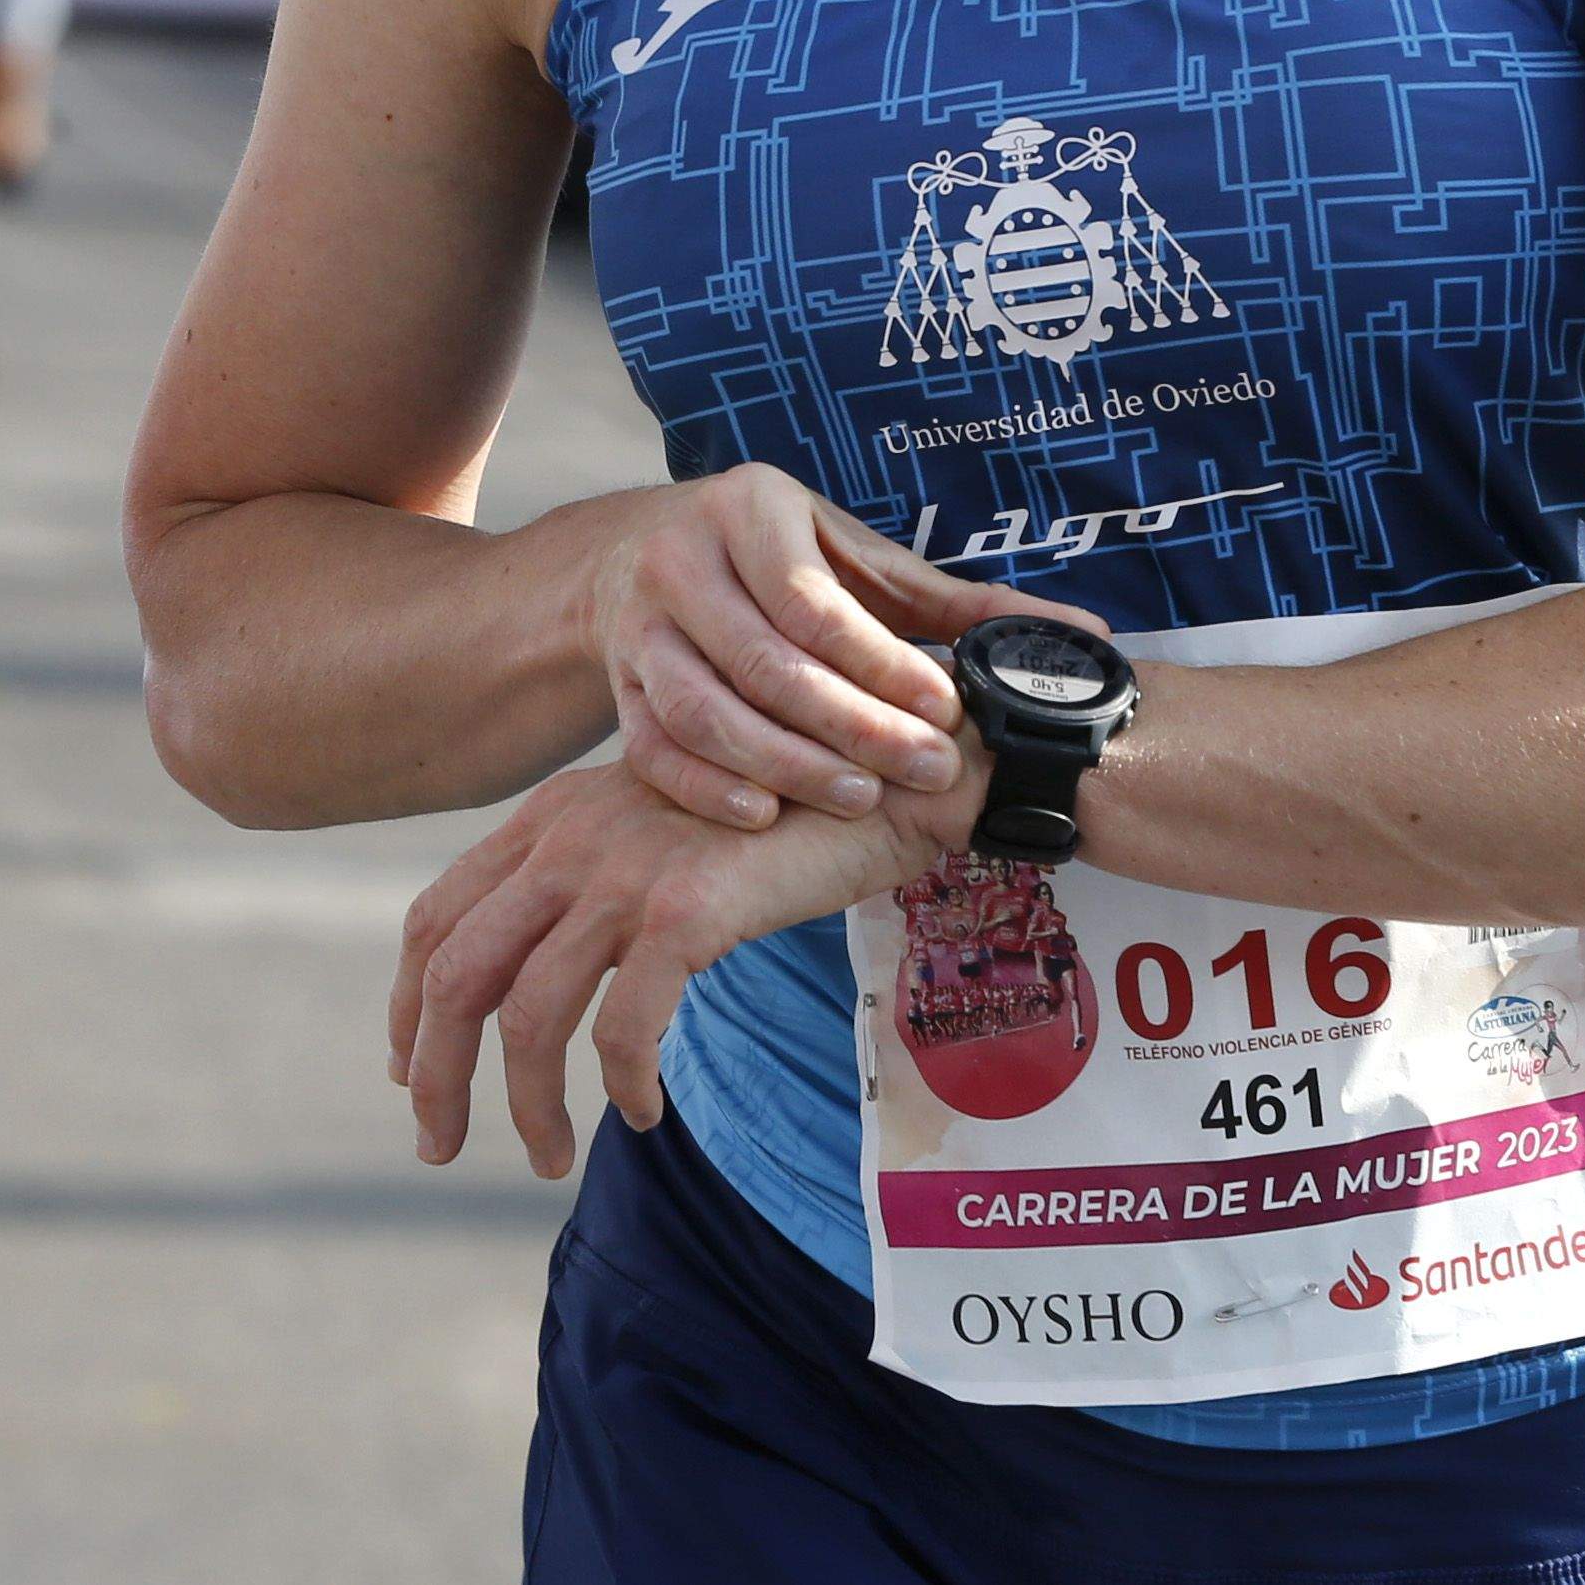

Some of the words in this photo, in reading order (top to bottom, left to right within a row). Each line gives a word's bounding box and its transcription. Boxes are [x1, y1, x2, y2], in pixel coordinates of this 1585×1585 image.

[878, 393, 1094, 455] Universidad
[1102, 388, 1144, 420] de
[1152, 372, 1277, 413] Oviedo
[1115, 916, 1392, 1041] 016
[1124, 1043, 1205, 1061] TELÉFONO
[1209, 1034, 1297, 1057] VIOLENCIA
[1302, 1028, 1324, 1044] DE
[1328, 1017, 1392, 1041] GÉNERO
[1468, 1039, 1527, 1062] Carrera
[1200, 1067, 1324, 1139] 461
[1508, 1056, 1551, 1087] Mujer
[956, 1185, 1169, 1229] CARRERA
[1183, 1180, 1247, 1217] DE
[1262, 1171, 1321, 1210] LA
[1335, 1140, 1481, 1201] MUJER
[1497, 1117, 1579, 1169] 2023
[952, 1289, 1184, 1345] OYSHO
